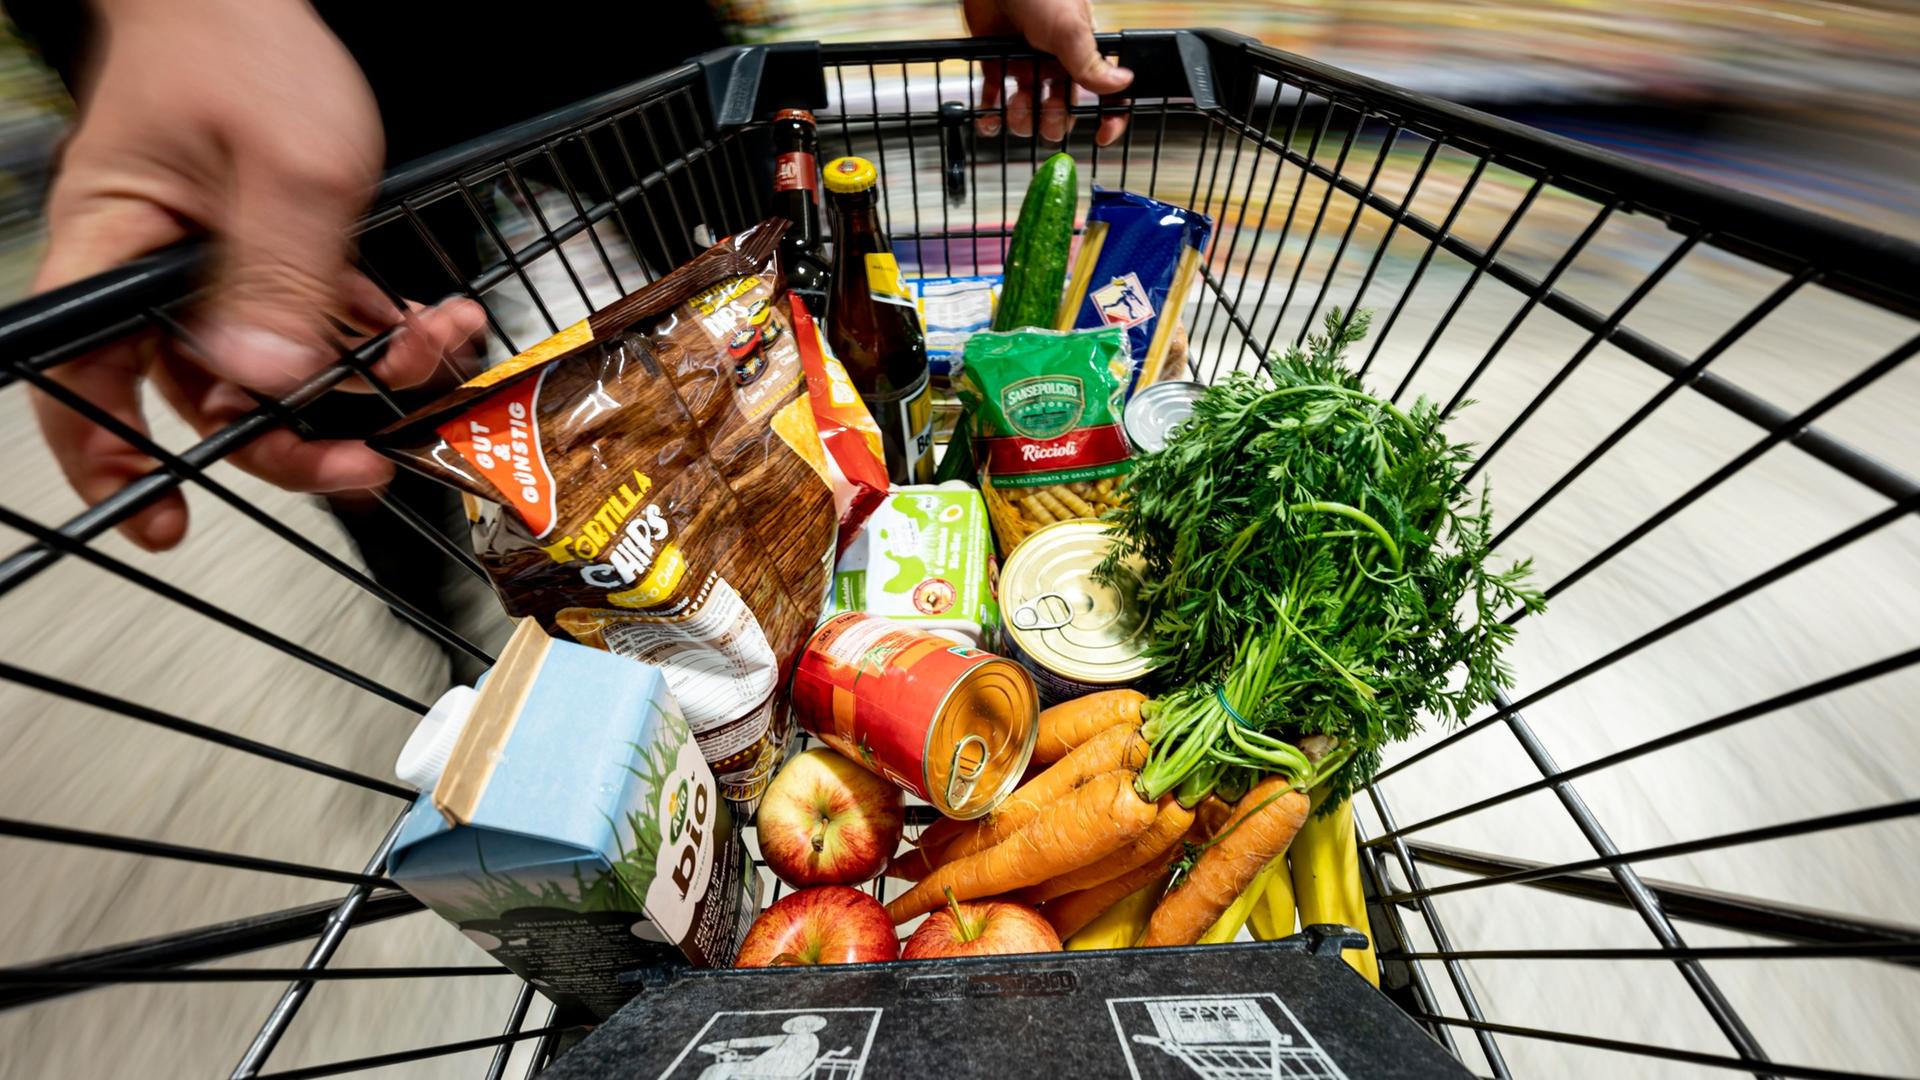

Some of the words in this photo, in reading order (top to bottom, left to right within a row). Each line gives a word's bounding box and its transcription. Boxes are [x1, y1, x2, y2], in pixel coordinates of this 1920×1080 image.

[1007, 382, 1078, 405] SANSEPOLCRO
[470, 420, 496, 470] GUT
[492, 443, 511, 462] &
[508, 401, 540, 504] GÜNSTIG
[1021, 441, 1078, 462] Riccioli
[1016, 475, 1060, 484] SELEZIONATA
[1071, 471, 1096, 479] GRANO
[541, 468, 653, 564] TORTILLA
[580, 503, 669, 589] CHIPS
[672, 786, 688, 838] Arla
[671, 783, 708, 902] bio
